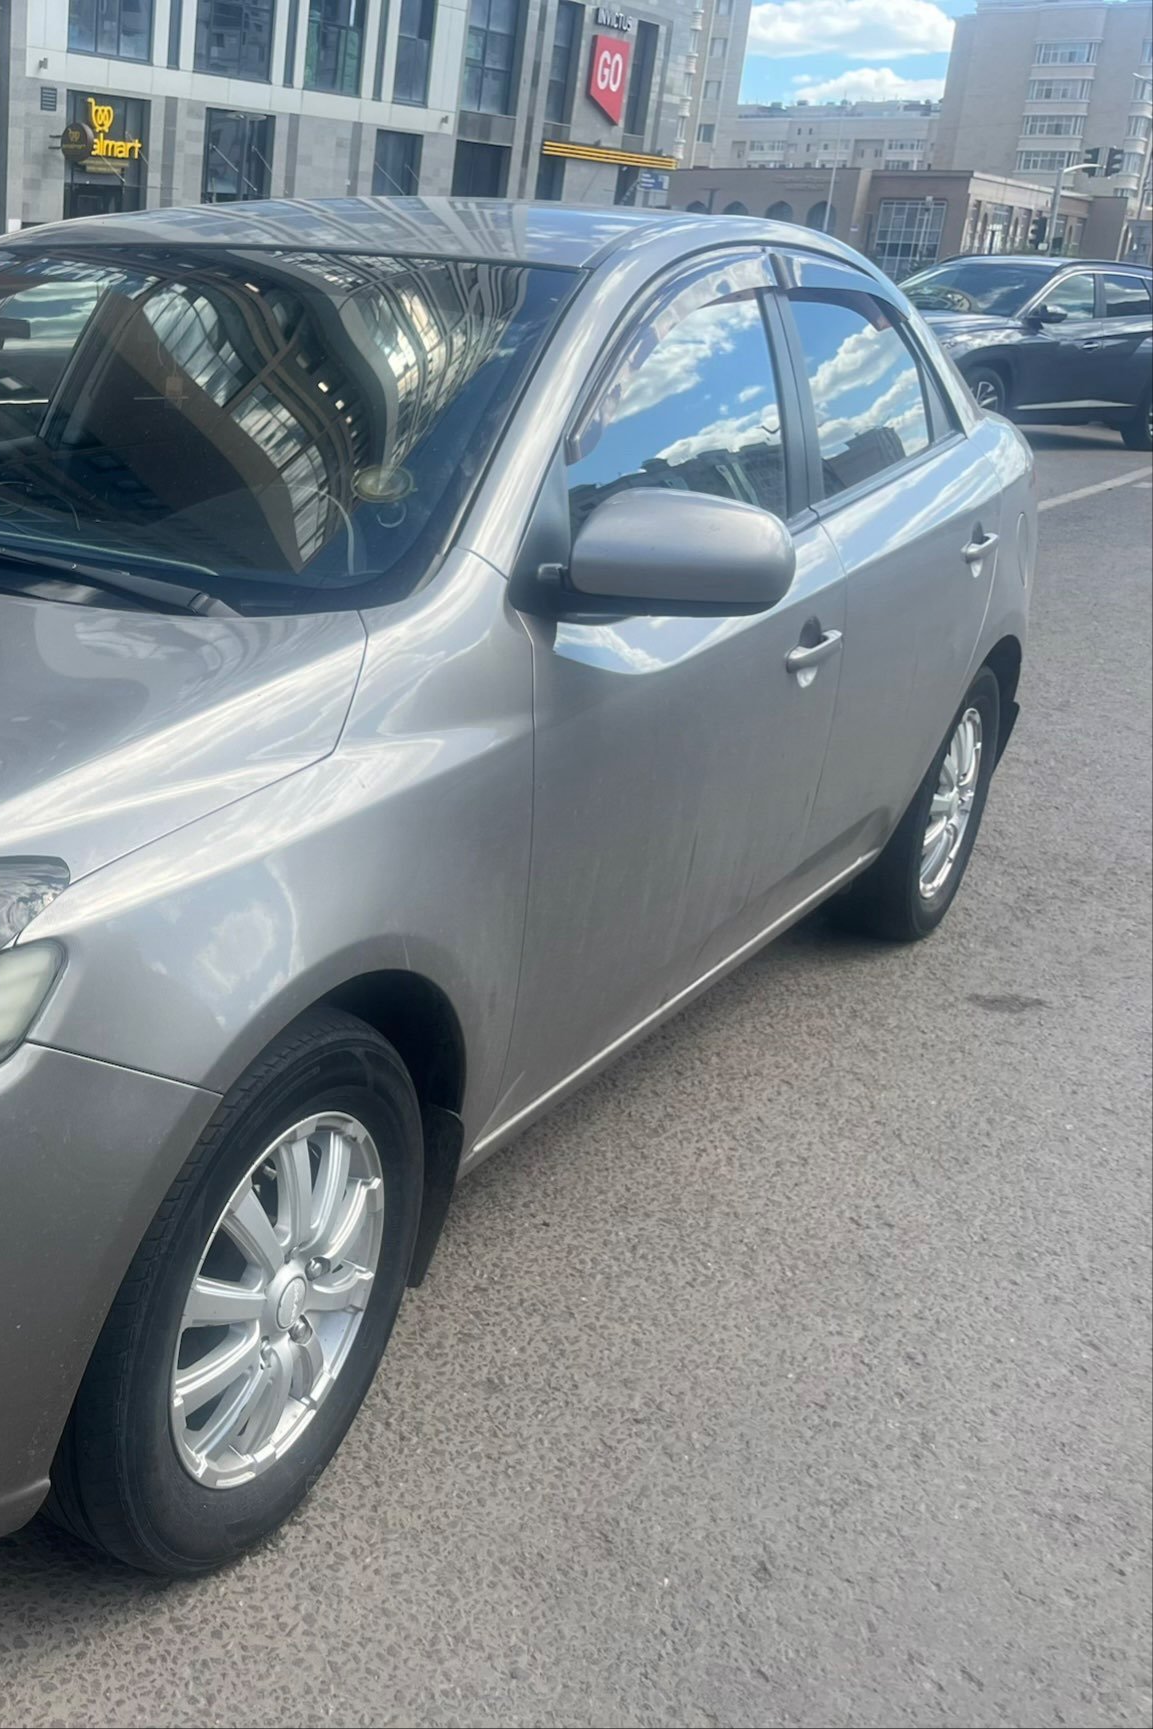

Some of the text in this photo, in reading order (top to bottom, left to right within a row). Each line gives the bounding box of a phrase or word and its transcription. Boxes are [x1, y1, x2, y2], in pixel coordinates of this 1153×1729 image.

[597, 7, 632, 32] INVICTUS
[597, 50, 623, 92] GO
[91, 132, 142, 159] almart
